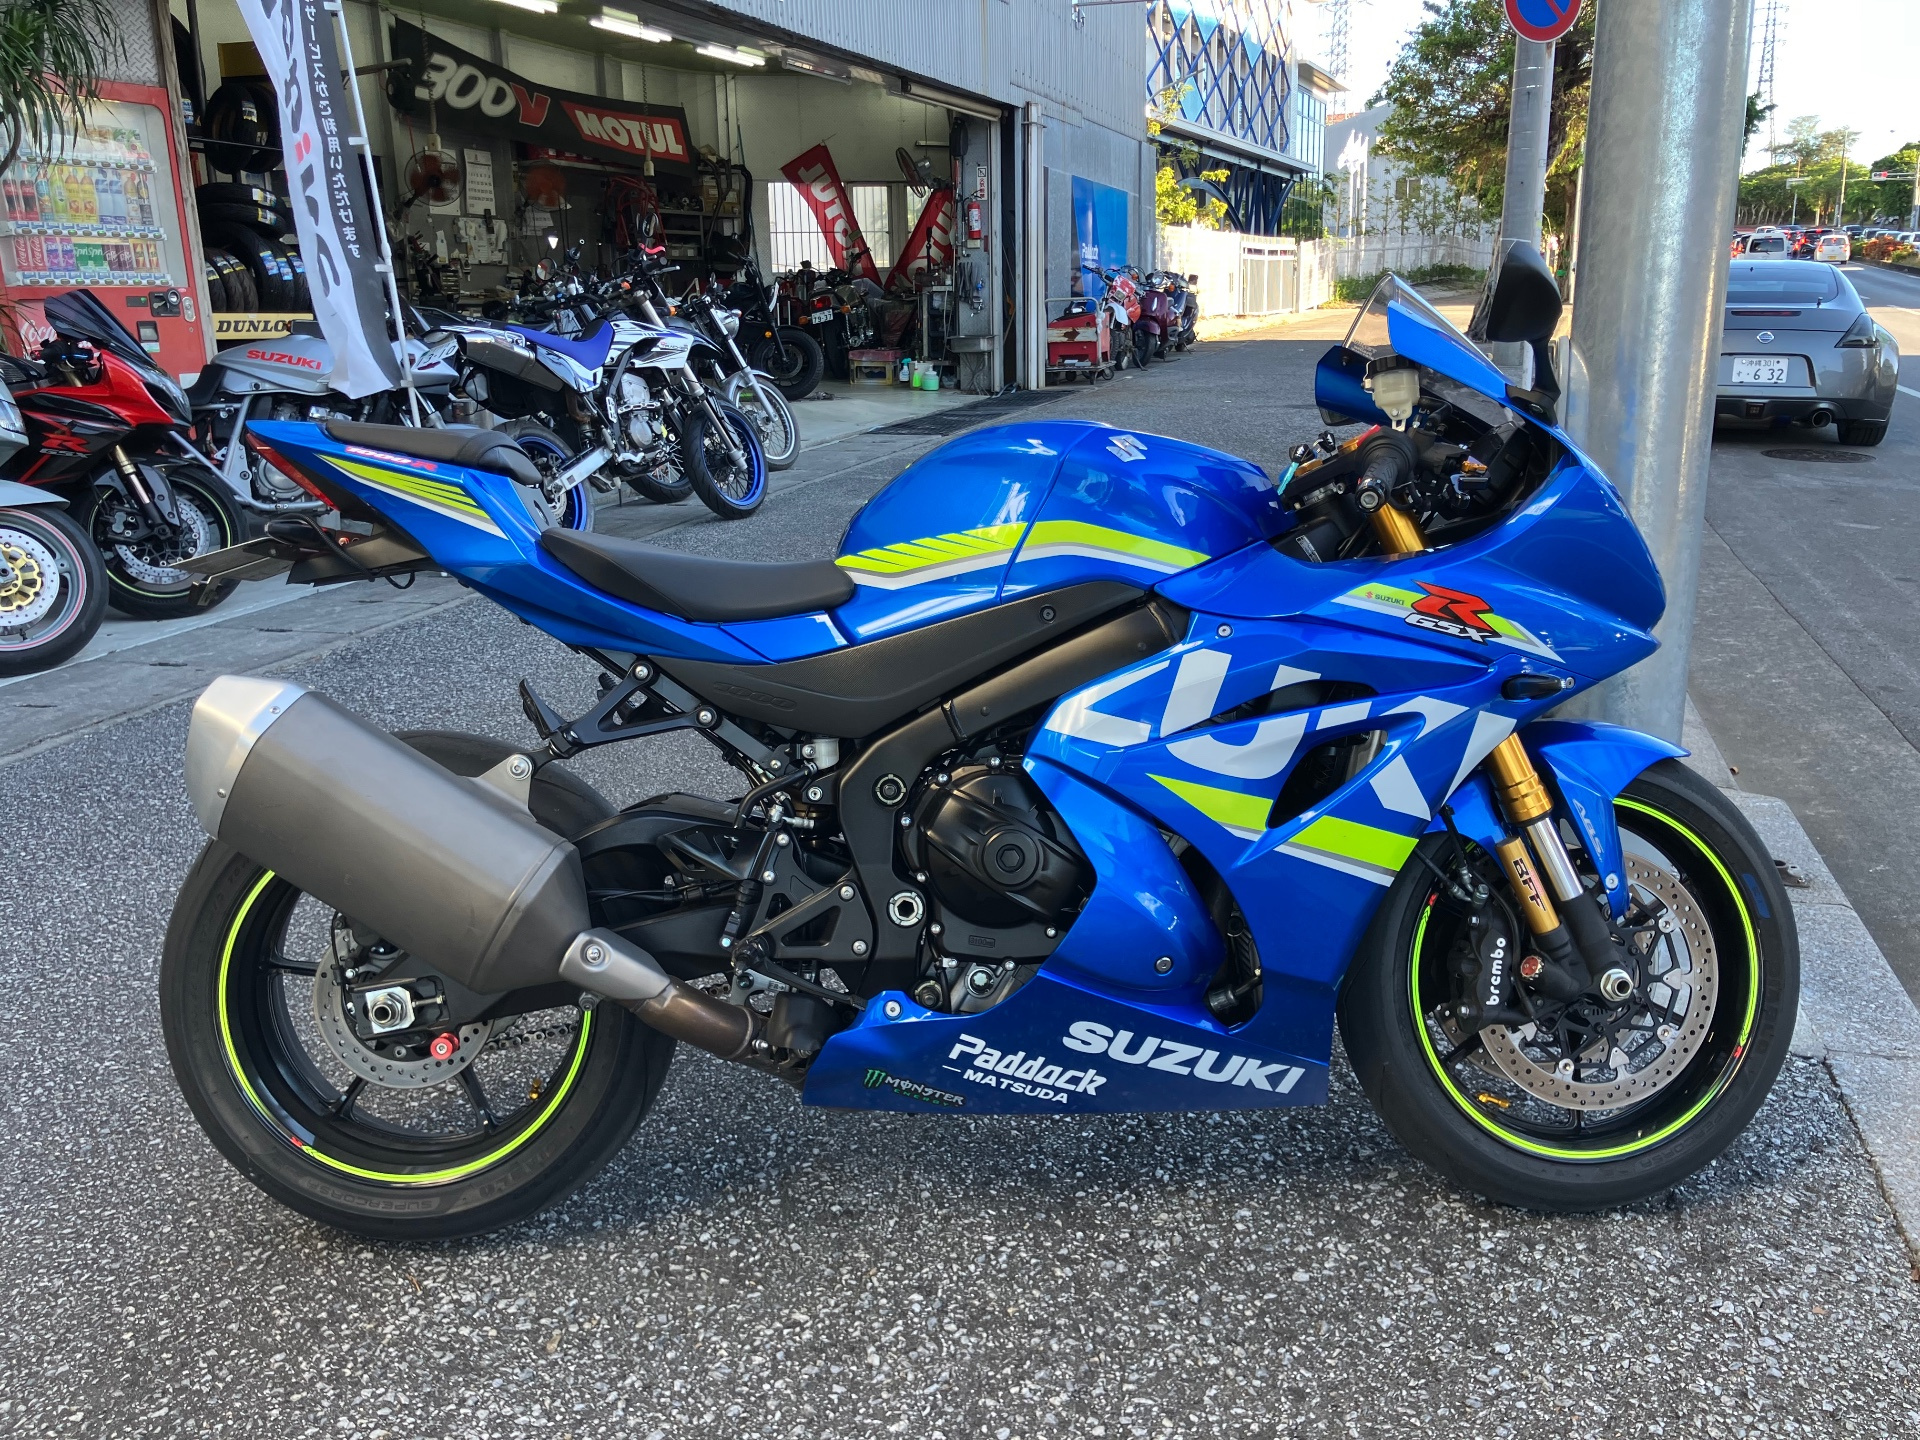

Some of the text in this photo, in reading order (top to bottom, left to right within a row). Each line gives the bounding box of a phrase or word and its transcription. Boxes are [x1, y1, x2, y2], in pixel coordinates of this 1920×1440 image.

[415, 52, 550, 127] 300V
[575, 109, 683, 156] MOTUL
[216, 320, 286, 333] DUNLO
[246, 349, 322, 370] SUZUKI
[1375, 593, 1405, 606] SUZUKI
[1404, 613, 1493, 645] GSX
[1485, 937, 1506, 1006] brembo
[948, 1033, 1107, 1096] Paddock
[1062, 1021, 1305, 1094] SUZUKI
[885, 1076, 964, 1106] MONSTER
[963, 1069, 1069, 1104] MATSUDA
